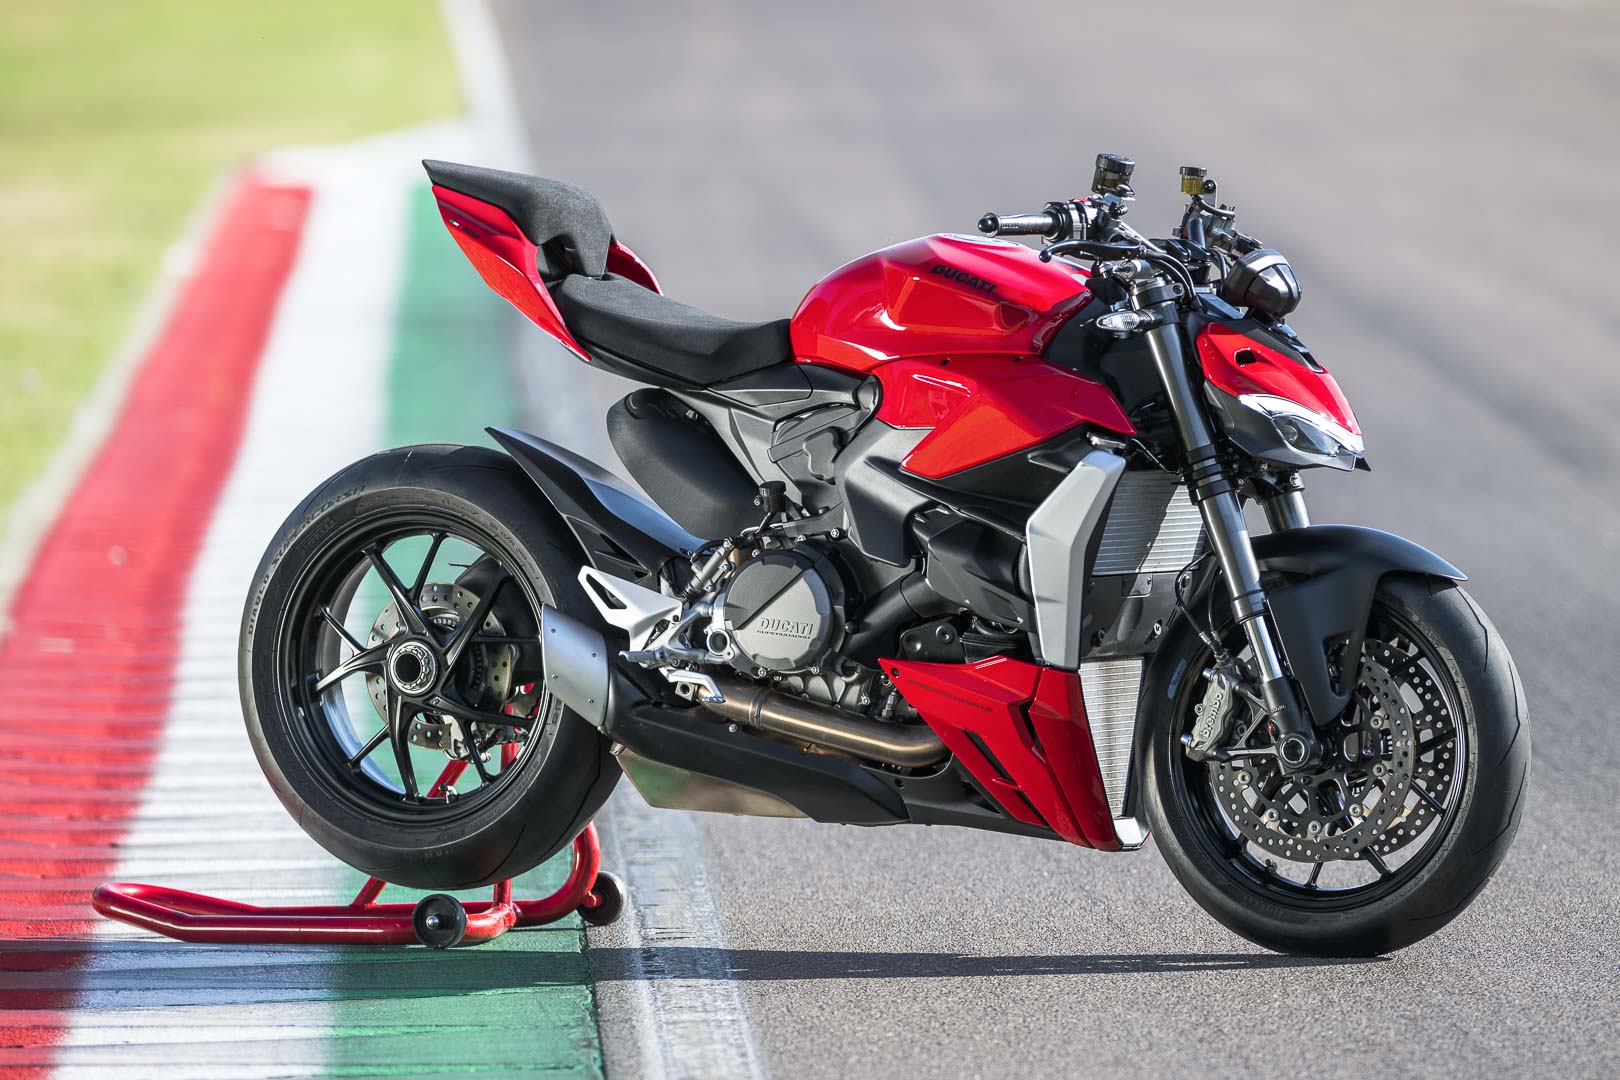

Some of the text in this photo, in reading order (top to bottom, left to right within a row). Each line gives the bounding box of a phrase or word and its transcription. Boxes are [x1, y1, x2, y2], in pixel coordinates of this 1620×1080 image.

[931, 264, 998, 293] DUCATI
[248, 573, 270, 636] DIABLO
[760, 617, 814, 635] DUCATI
[1199, 692, 1224, 738] brembo
